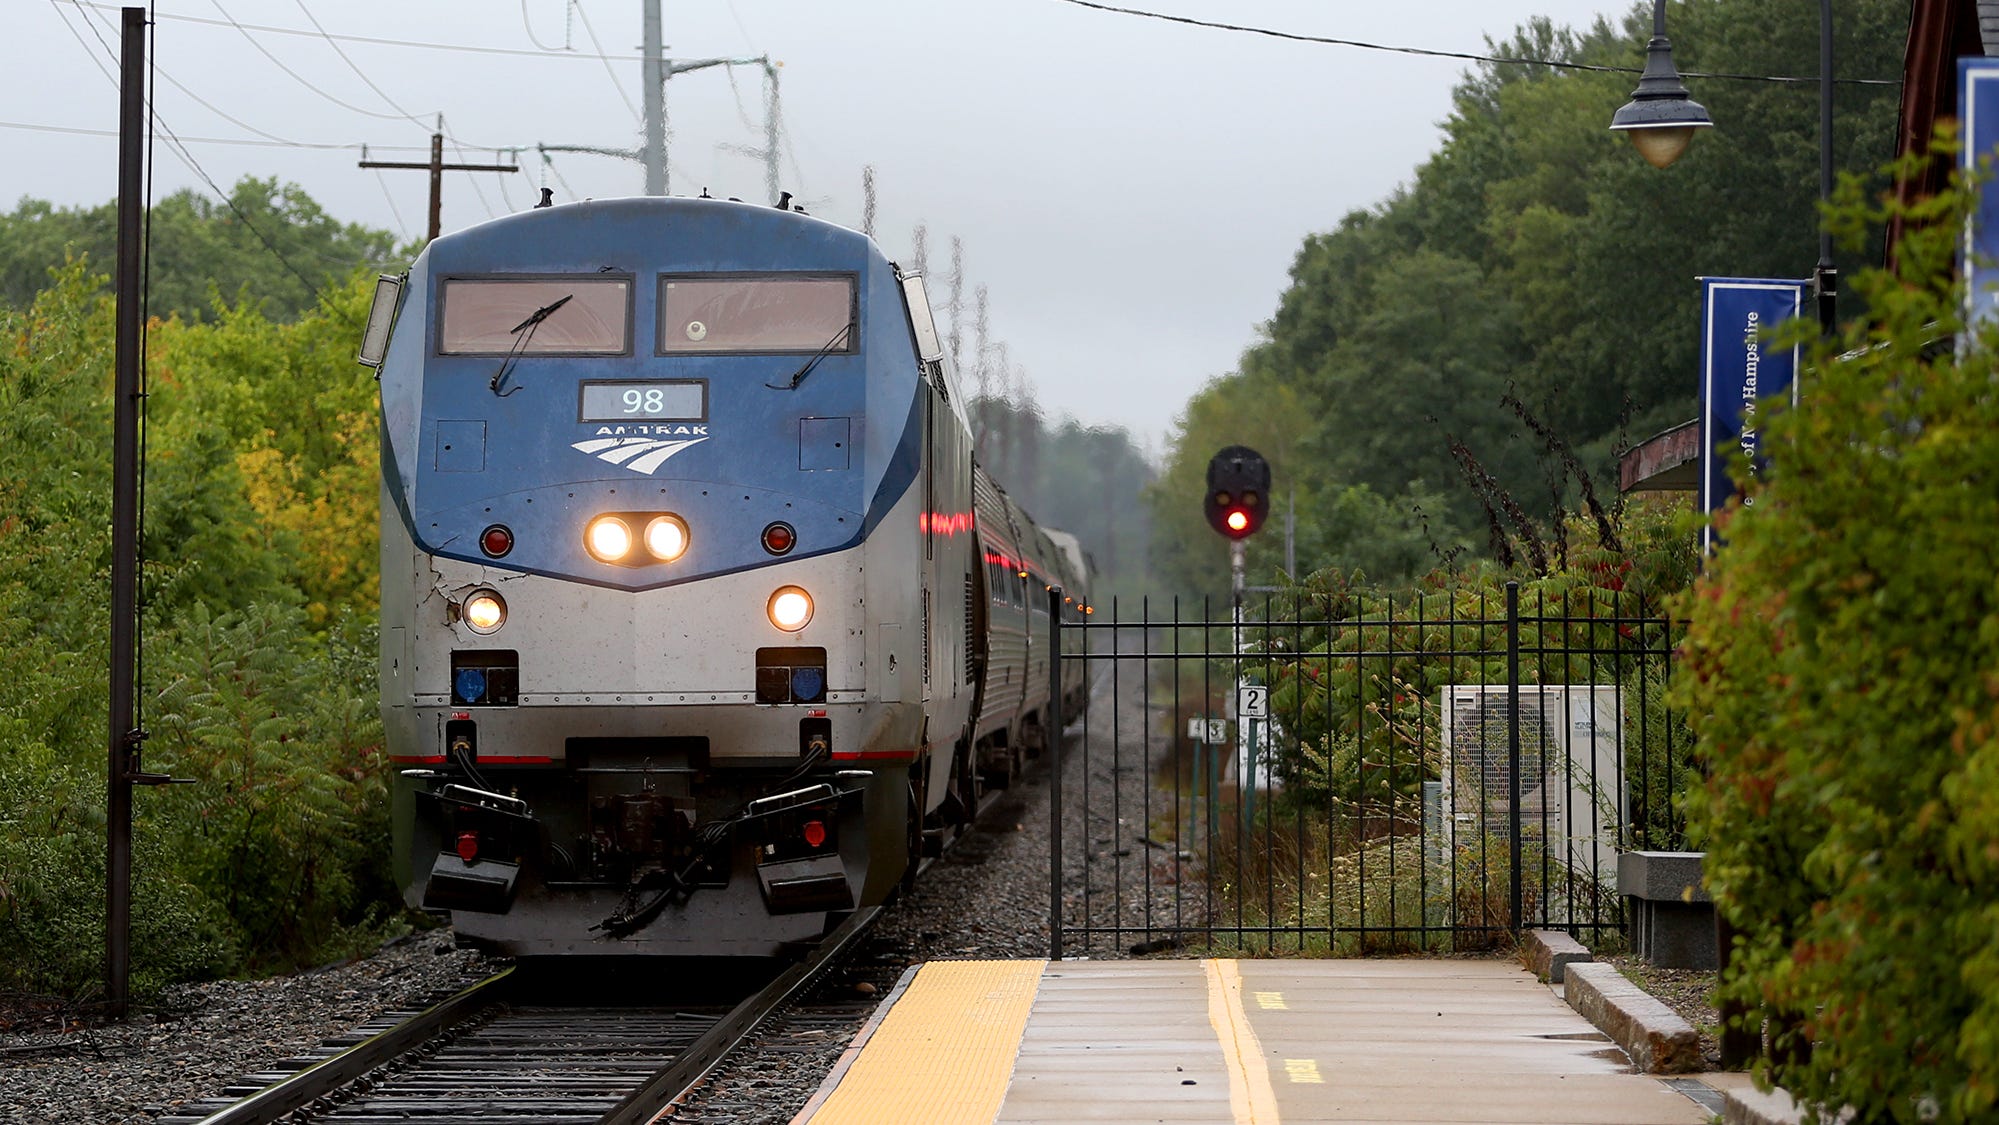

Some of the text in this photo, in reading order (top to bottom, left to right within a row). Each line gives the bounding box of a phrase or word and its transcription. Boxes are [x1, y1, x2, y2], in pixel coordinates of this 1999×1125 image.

[622, 389, 664, 413] 98
[1741, 442, 1755, 458] of
[1247, 690, 1259, 709] 2
[1210, 722, 1219, 737] 3
